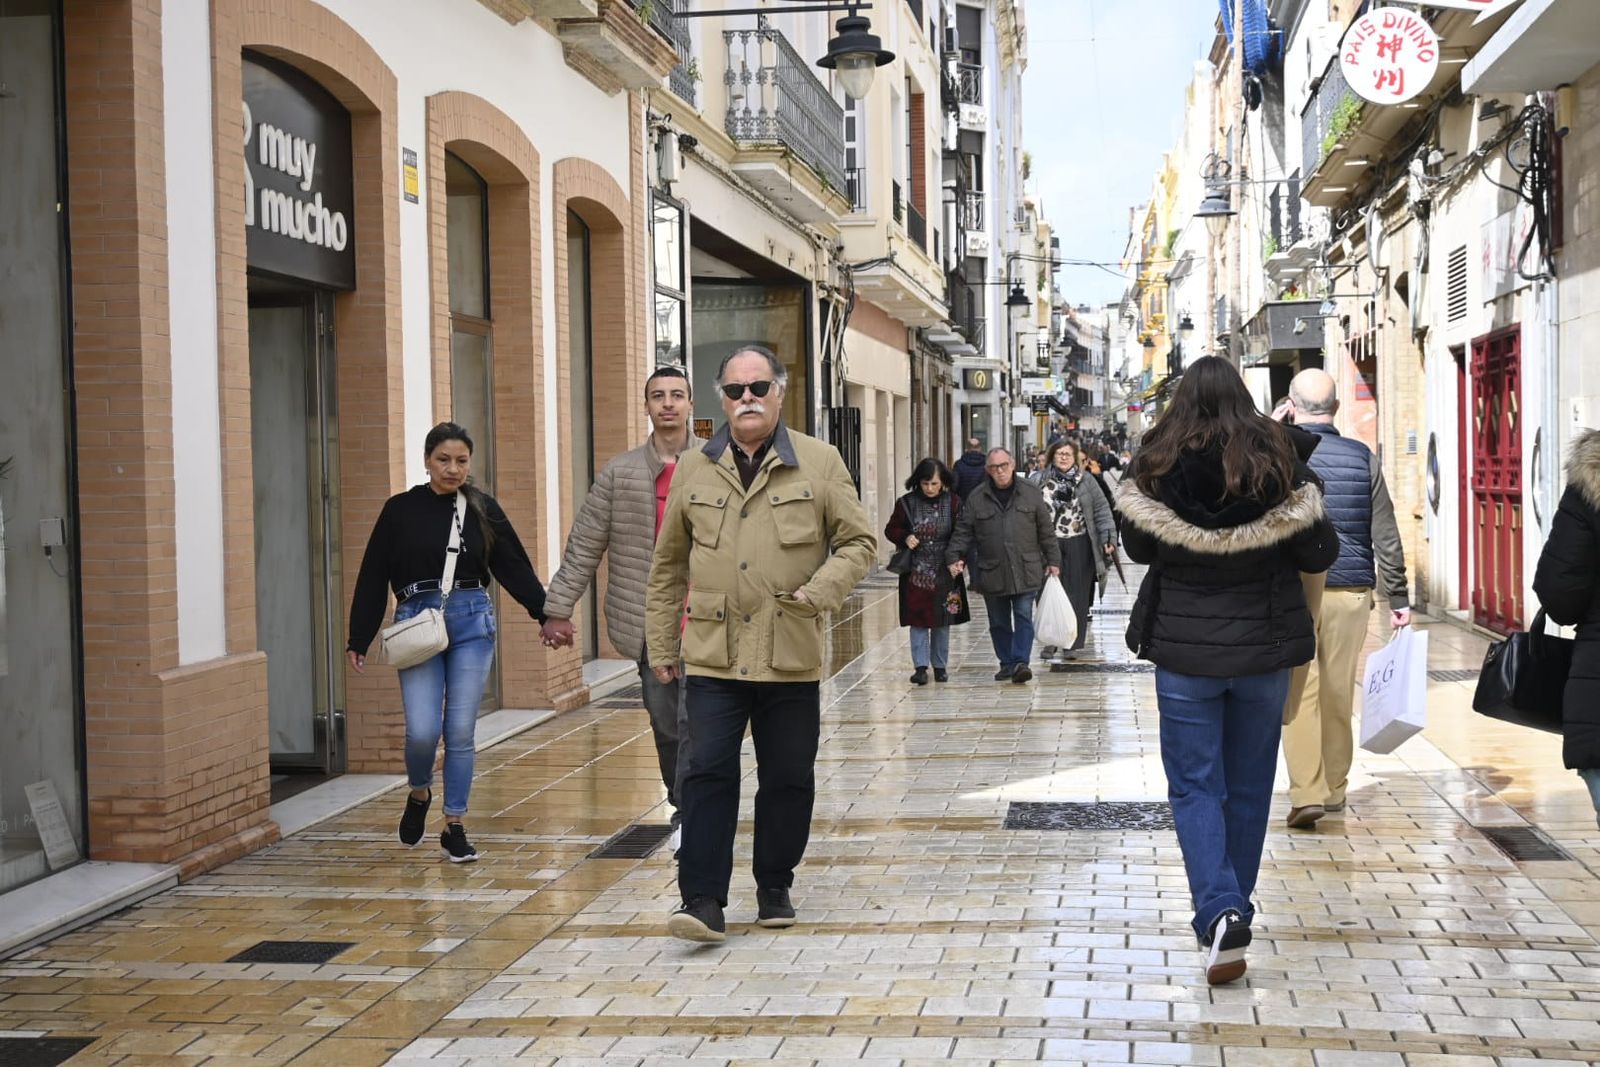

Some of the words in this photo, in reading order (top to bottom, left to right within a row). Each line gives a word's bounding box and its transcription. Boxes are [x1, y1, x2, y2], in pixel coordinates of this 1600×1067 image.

[1345, 18, 1376, 66] PAIS
[1382, 12, 1435, 63] DIVINO
[259, 122, 317, 192] muy
[261, 188, 348, 252] mucho
